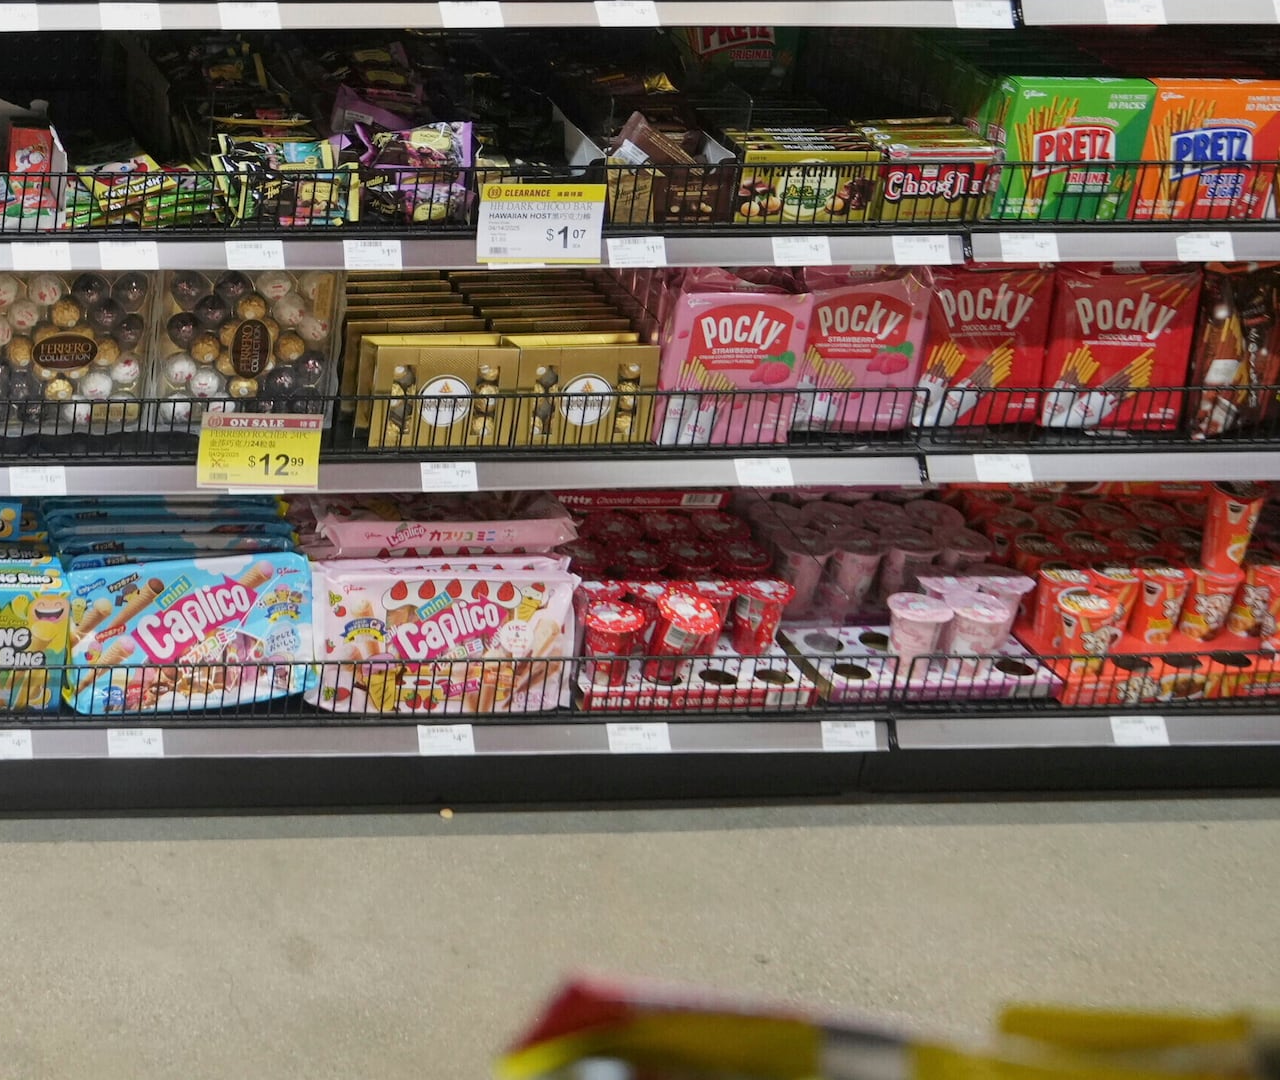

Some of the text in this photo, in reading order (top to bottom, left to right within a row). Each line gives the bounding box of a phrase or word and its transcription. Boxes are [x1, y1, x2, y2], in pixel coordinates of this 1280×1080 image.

[1038, 126, 1114, 161] PRETZ
[1175, 127, 1251, 163] PRETZ
[505, 189, 552, 197] CLEARANCE
[546, 226, 586, 249] $1 07
[39, 352, 91, 363] COLLECTION
[40, 343, 91, 356] FERRERO
[714, 348, 760, 356] STRAWBERRY
[230, 419, 286, 428] ON SALE
[290, 457, 304, 466] 99
[158, 578, 190, 608] mini
[420, 593, 449, 619] mini
[135, 580, 252, 655] Caplico
[397, 599, 502, 661] Caplico
[590, 694, 634, 707] Hello
